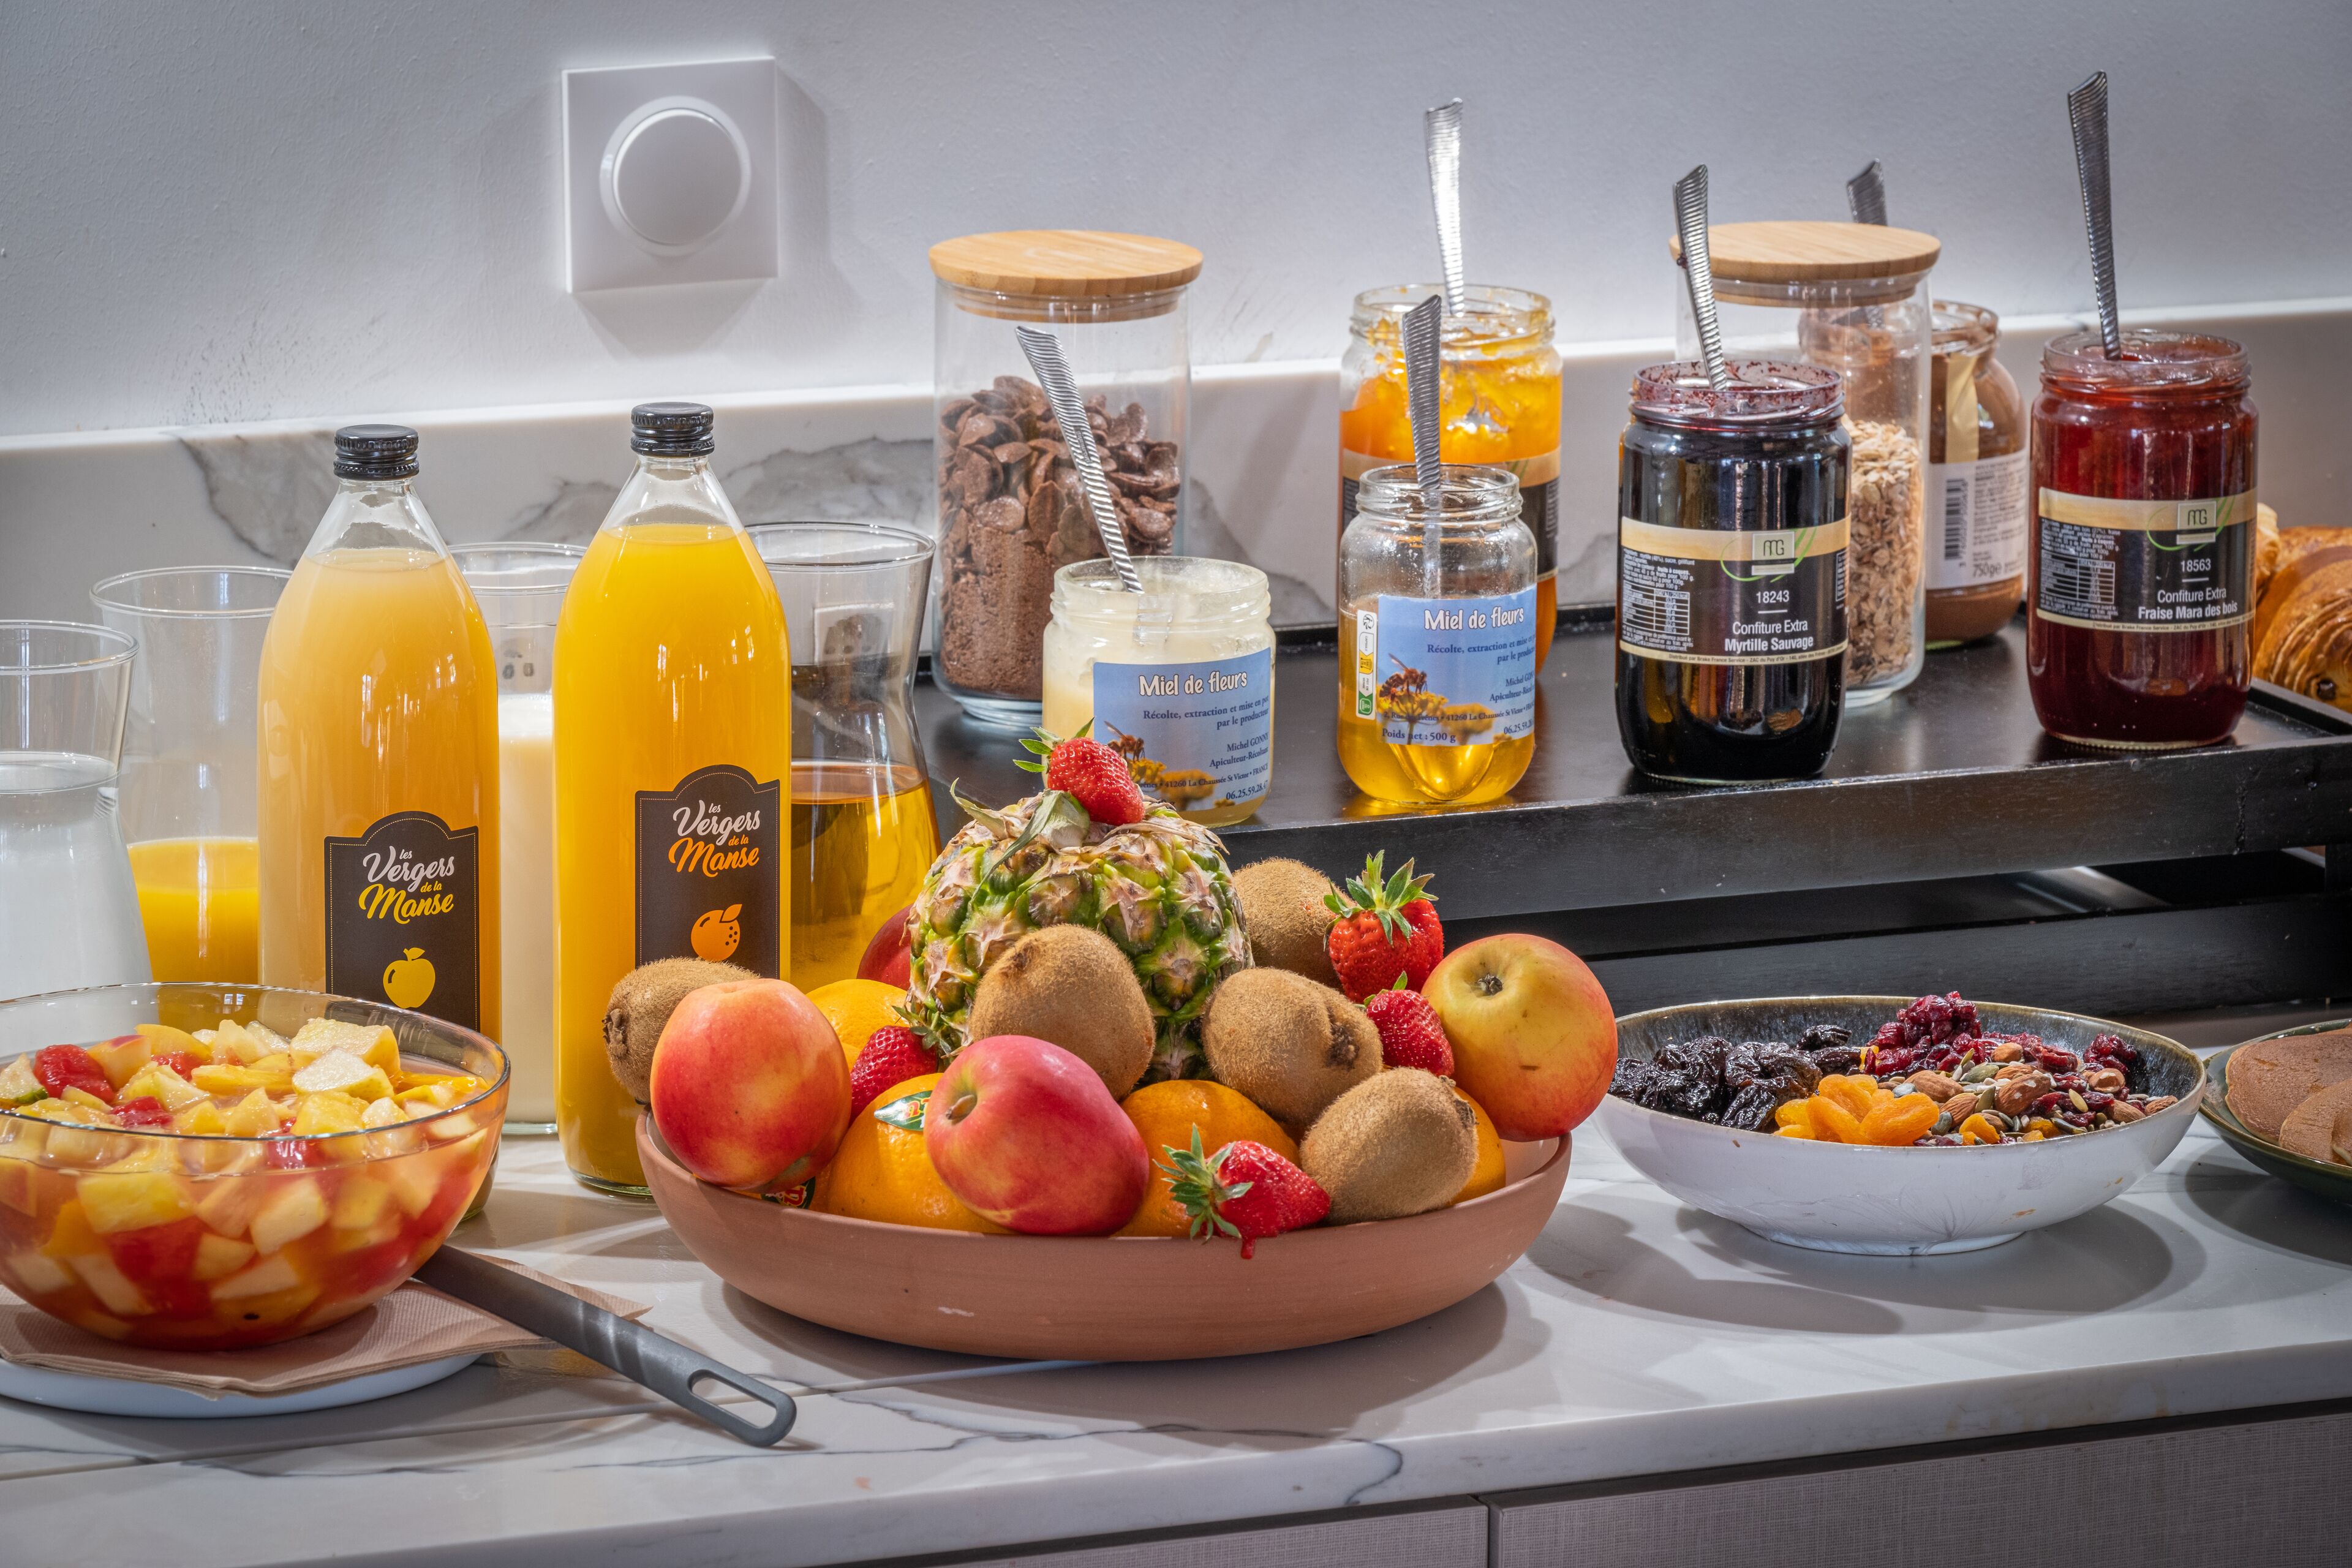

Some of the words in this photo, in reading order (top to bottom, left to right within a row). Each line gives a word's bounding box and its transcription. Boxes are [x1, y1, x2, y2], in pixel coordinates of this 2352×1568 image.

[2180, 559, 2211, 572] 18563
[1756, 590, 1789, 604] 18243
[2157, 589, 2204, 604] Confiture
[2206, 587, 2226, 600] Extra
[2138, 606, 2173, 620] Fraise
[2176, 606, 2203, 619] Mara
[2205, 603, 2221, 617] des
[2222, 601, 2237, 614] bois
[1424, 609, 1463, 631] Miel
[1468, 608, 1486, 629] de
[1491, 606, 1524, 628] fleurs
[1733, 620, 1782, 635] Confiture
[1784, 619, 1808, 632] Extra
[1427, 644, 1464, 654] Récolte,
[1468, 642, 1507, 652] extraction
[1517, 637, 1528, 647] mise
[1725, 638, 1768, 654] Myrtille
[1771, 636, 1814, 650] Sauvage
[1497, 655, 1509, 665] par
[1510, 651, 1516, 660] le
[1139, 674, 1178, 696] Miel
[1184, 675, 1204, 694] de
[1208, 671, 1248, 693] fleurs
[1506, 674, 1523, 687] Michel
[1144, 710, 1182, 720] Récolte,
[1185, 707, 1227, 718] extraction
[1239, 701, 1253, 710] mise
[1479, 711, 1504, 720] Chaussée
[1217, 720, 1230, 730] par
[1232, 716, 1238, 725] le
[1382, 728, 1405, 739] Poids
[1430, 733, 1447, 741] 500
[1450, 734, 1456, 743] g
[1227, 740, 1249, 752] Michel
[1198, 777, 1226, 786] Chaussée
[709, 803, 721, 813] les
[673, 799, 760, 846] Vergers
[728, 835, 739, 846] de
[741, 834, 748, 845] la
[399, 849, 412, 860] les
[668, 837, 760, 878] Manse
[363, 845, 454, 892] Vergers
[420, 881, 432, 893] de
[433, 881, 442, 891] la
[358, 883, 454, 925] Manse
